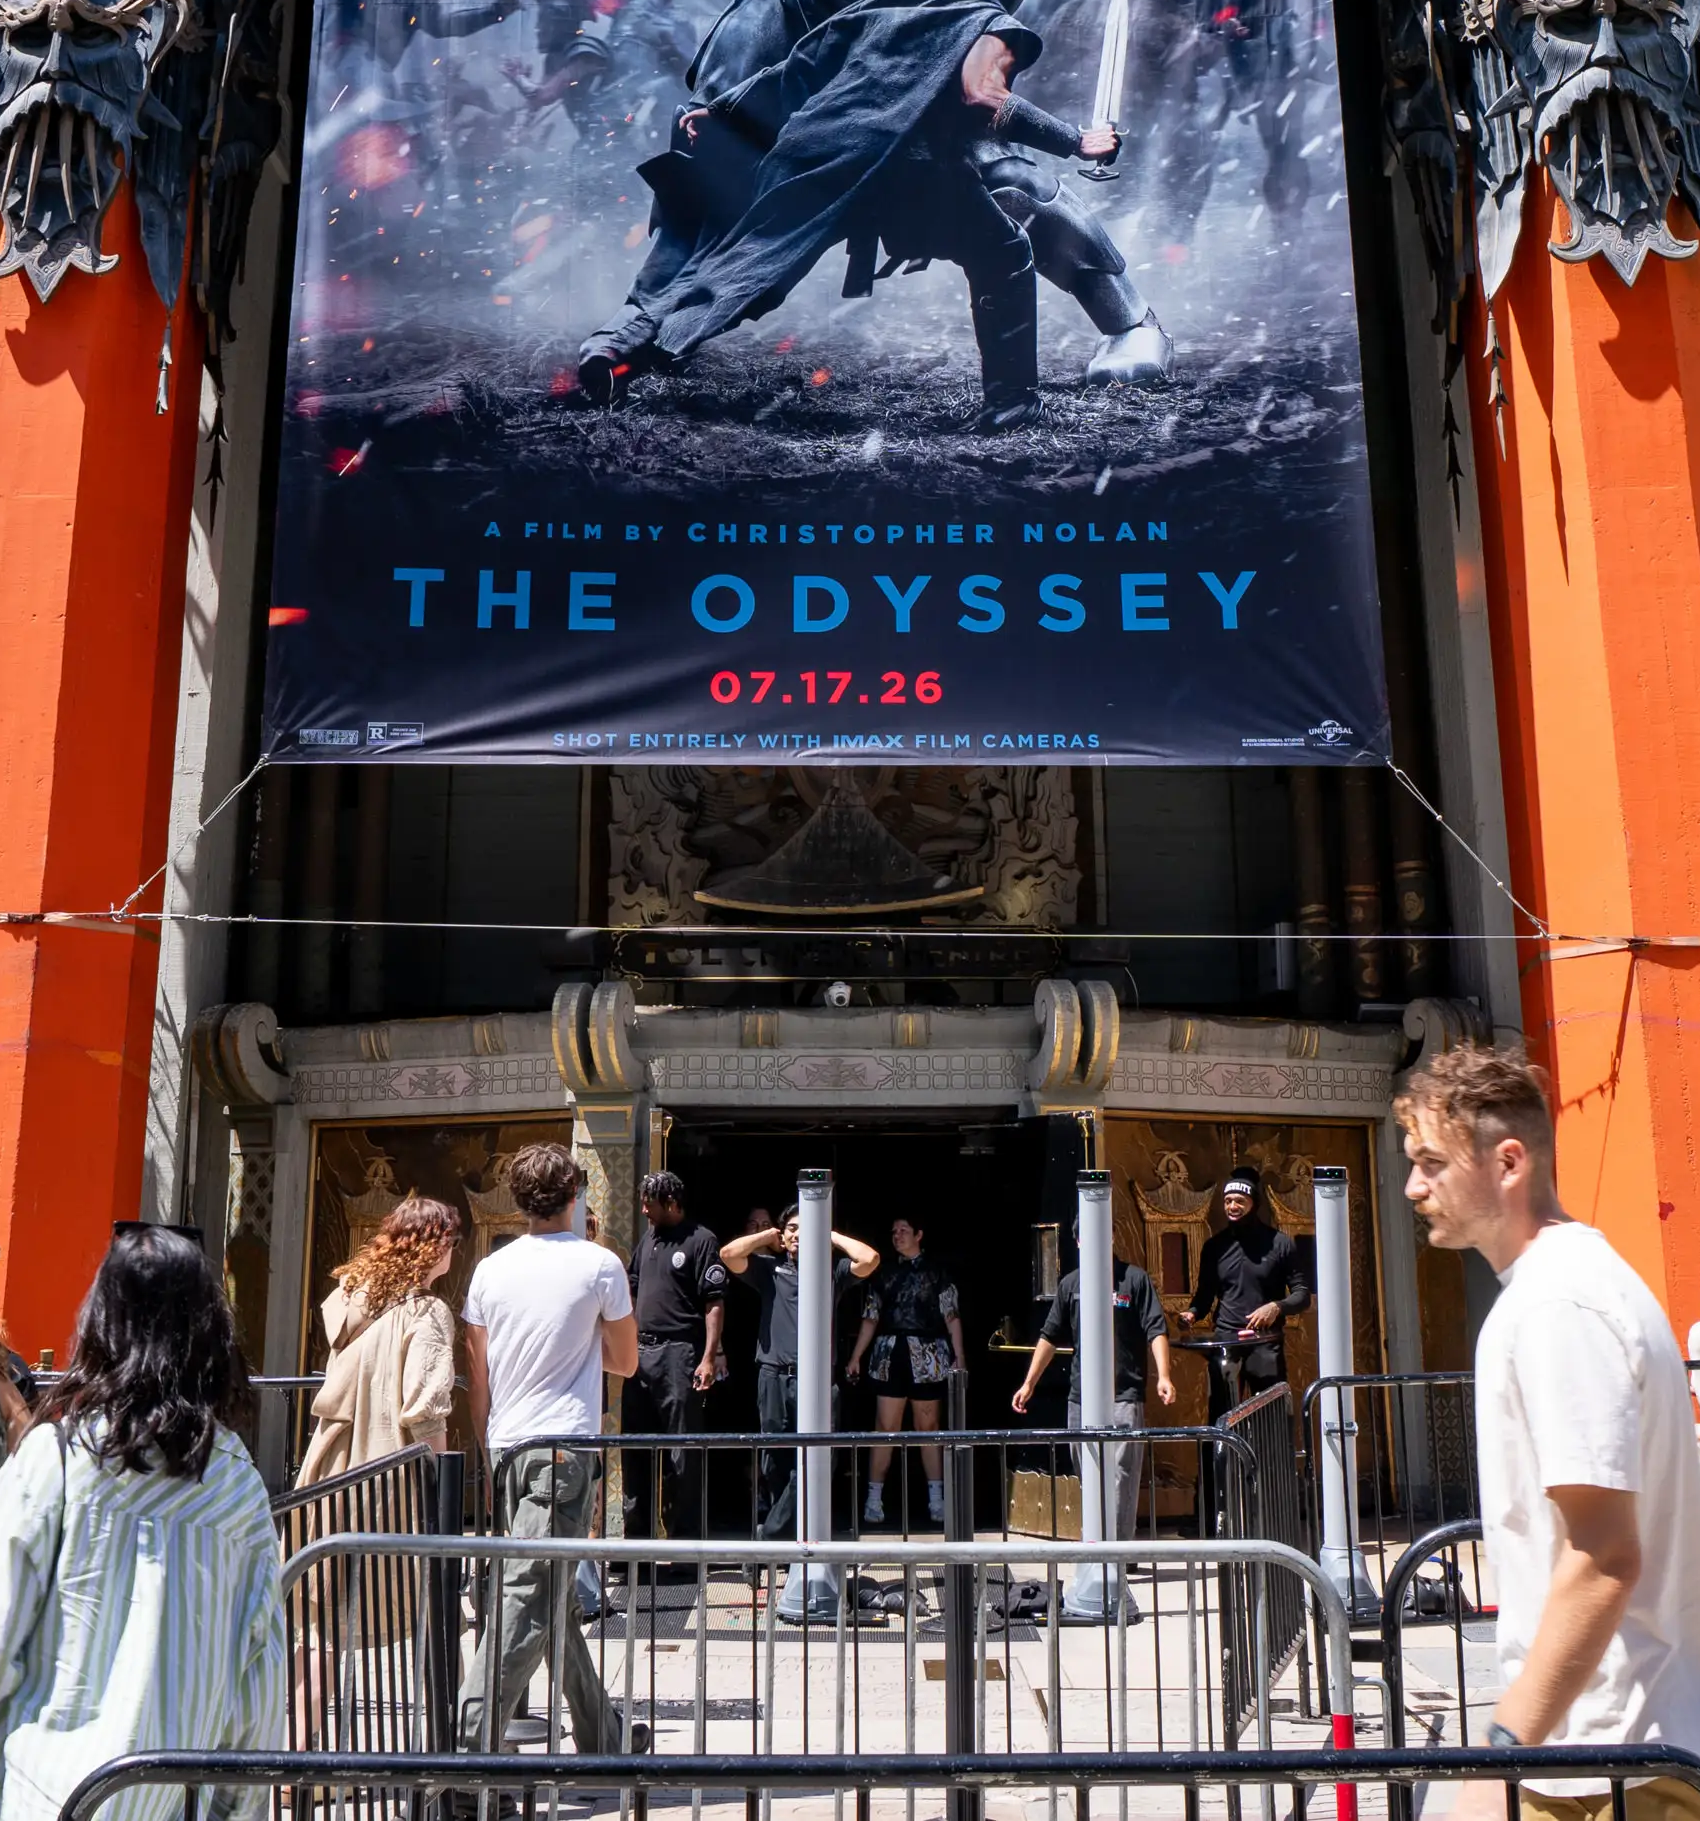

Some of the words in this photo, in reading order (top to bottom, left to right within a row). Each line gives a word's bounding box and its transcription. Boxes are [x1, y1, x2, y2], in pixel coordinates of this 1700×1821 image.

[484, 522, 500, 537] A
[525, 522, 602, 539] FILM
[625, 524, 663, 541] BY
[687, 522, 994, 544] CHRISTOPHER
[1023, 521, 1168, 542] NOLAN
[393, 567, 617, 632] THE
[691, 570, 1257, 634] ODYSSEY
[710, 671, 943, 704] 07.17.26
[369, 727, 384, 740] R
[1308, 726, 1353, 736] UNIVERSAL
[553, 733, 618, 748] SHOT
[629, 733, 747, 749] ENTIRELY
[758, 733, 821, 749] WITH
[833, 734, 902, 748] IMAX
[914, 734, 971, 748] FILM
[983, 733, 1100, 748] CAMERAS
